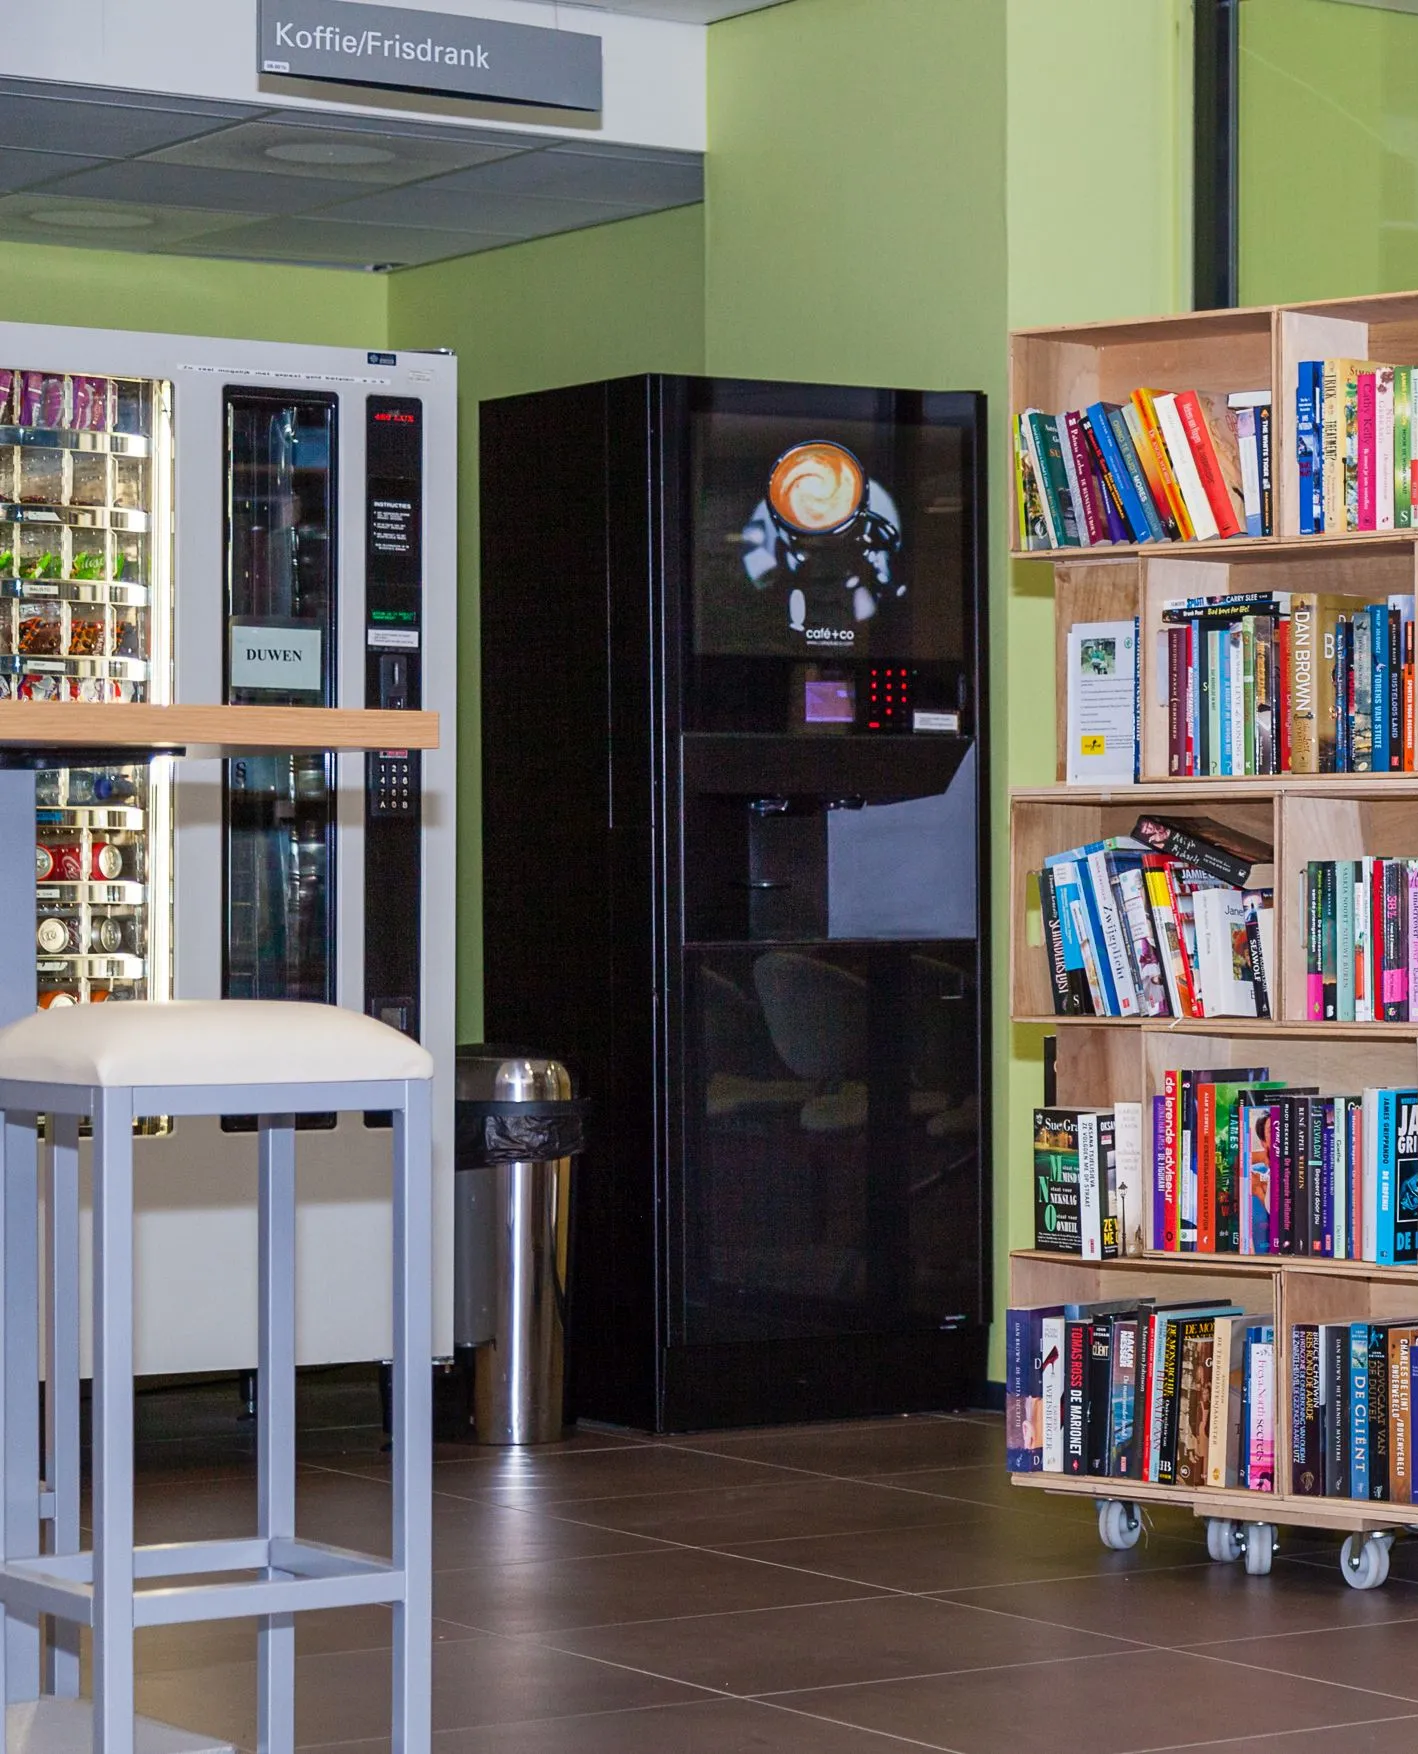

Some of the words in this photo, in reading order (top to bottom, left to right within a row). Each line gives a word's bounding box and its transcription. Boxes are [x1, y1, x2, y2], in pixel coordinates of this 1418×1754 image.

[276, 21, 490, 69] Koffie/Frisdrank
[1325, 374, 1337, 400] TRICK
[1363, 383, 1372, 414] Cathy
[1363, 417, 1373, 446] Kelly
[1262, 457, 1270, 477] TIGER
[1133, 475, 1147, 503] MORES
[1225, 594, 1244, 603] CARRY
[1244, 593, 1258, 602] SLEE
[805, 627, 855, 640] café+co
[1294, 611, 1311, 646] DAN
[247, 648, 302, 662] DUWEN
[1294, 650, 1311, 711] BROWN
[1374, 721, 1382, 749] STILTE
[1181, 868, 1204, 880] JAMIE
[1224, 905, 1245, 917] Jane
[1102, 905, 1125, 980] Zwijgplicht
[1249, 939, 1261, 982] SEAWOLF
[1164, 1077, 1175, 1094] de
[1045, 1117, 1061, 1132] Sue
[1164, 1097, 1175, 1145] lerende
[1230, 1113, 1239, 1150] JAMES
[1313, 1119, 1321, 1143] SYLVIA
[1298, 1129, 1306, 1151] APPEL
[1313, 1144, 1321, 1158] DAY
[1164, 1147, 1175, 1204] adviseur
[1103, 1218, 1113, 1232] ZE
[1283, 1198, 1291, 1230] Hollander
[1396, 1232, 1411, 1250] DE
[1071, 1327, 1083, 1361] TOMAS
[1368, 1360, 1375, 1374] DE
[1400, 1338, 1408, 1377] CHARLES
[1071, 1362, 1083, 1387] ROSS
[1306, 1375, 1313, 1388] DE
[1354, 1376, 1366, 1399] DE
[1400, 1380, 1408, 1391] DE
[1070, 1389, 1083, 1403] DE
[1258, 1387, 1266, 1418] North
[1368, 1378, 1377, 1422] DUIVEL
[1376, 1360, 1386, 1425] ADVOCAAT
[1400, 1392, 1408, 1412] LINT
[1069, 1405, 1083, 1456] MARIONET
[1257, 1418, 1266, 1462] secrets
[1354, 1404, 1366, 1473] CLIËNT
[1377, 1430, 1386, 1456] VAN
